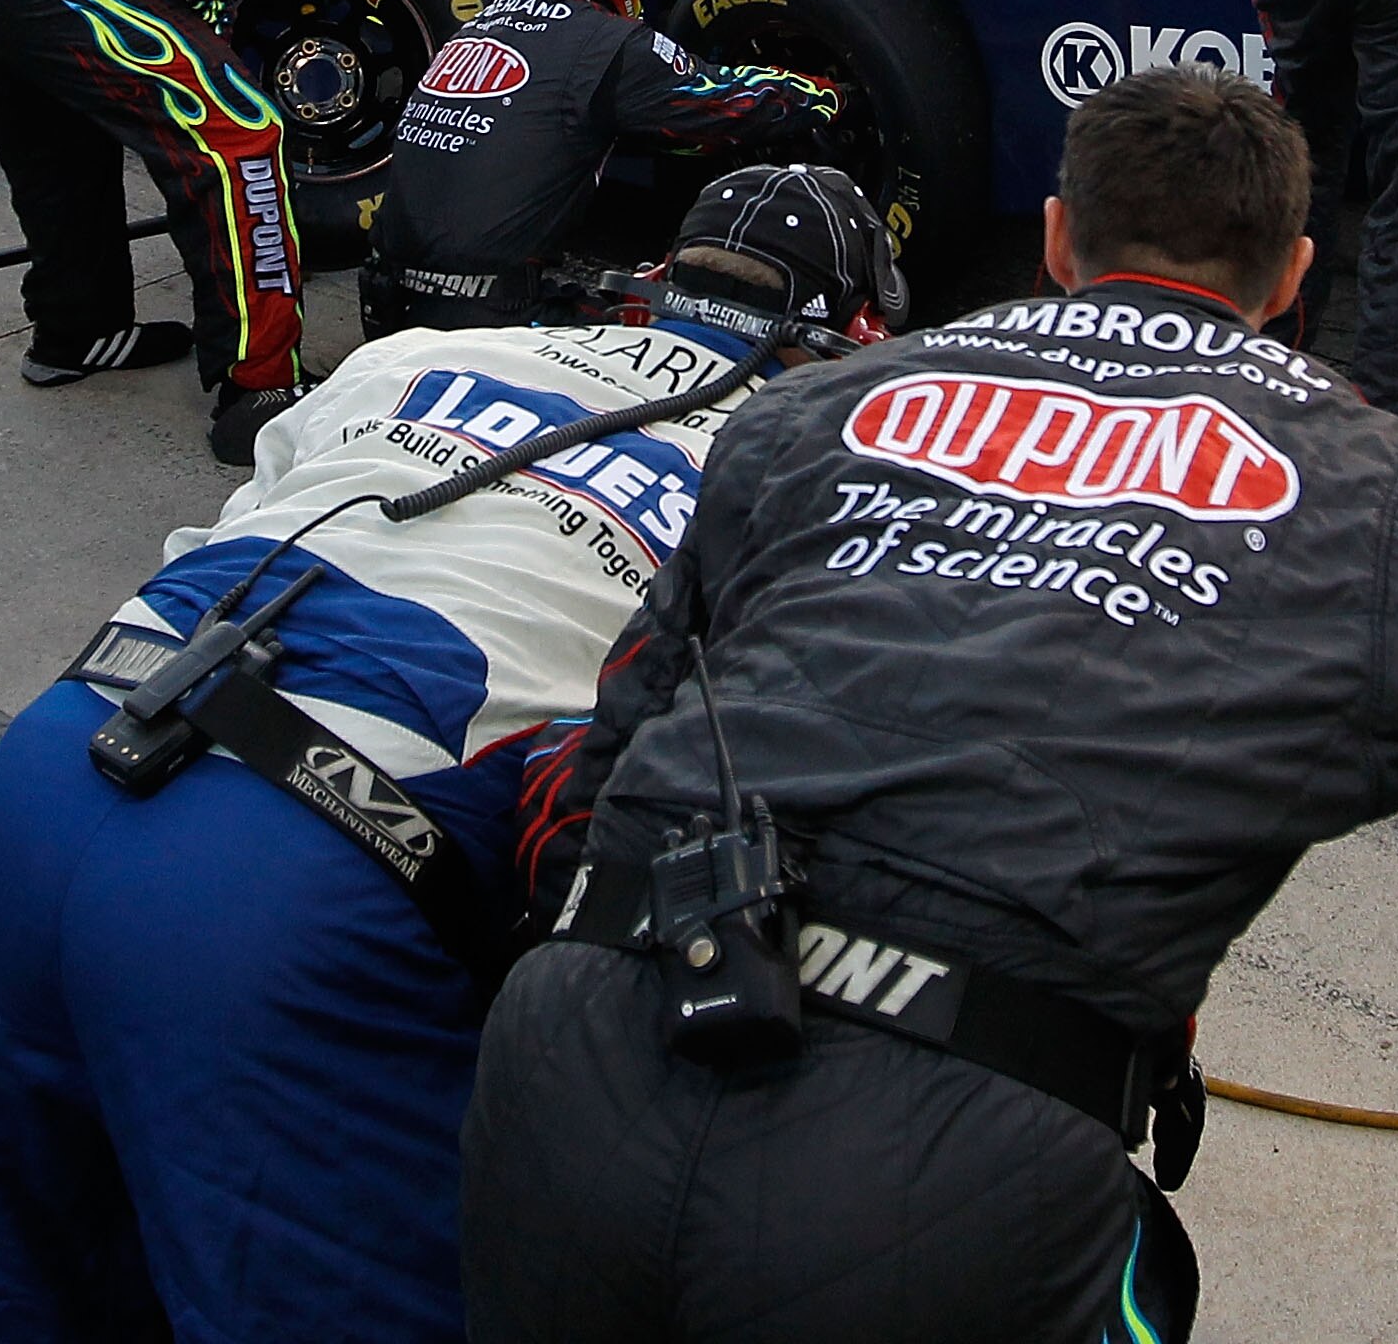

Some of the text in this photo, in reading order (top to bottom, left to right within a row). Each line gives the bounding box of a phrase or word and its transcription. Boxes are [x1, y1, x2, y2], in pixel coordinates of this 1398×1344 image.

[412, 98, 495, 135] miracles
[239, 157, 293, 295] DUPONT
[385, 423, 453, 470] Build
[875, 381, 1266, 507] DUPONT
[825, 521, 1152, 628] of science
[828, 481, 1231, 609] The miracles
[286, 766, 424, 883] MECHANIX WEAR
[798, 923, 951, 1018] ONT
